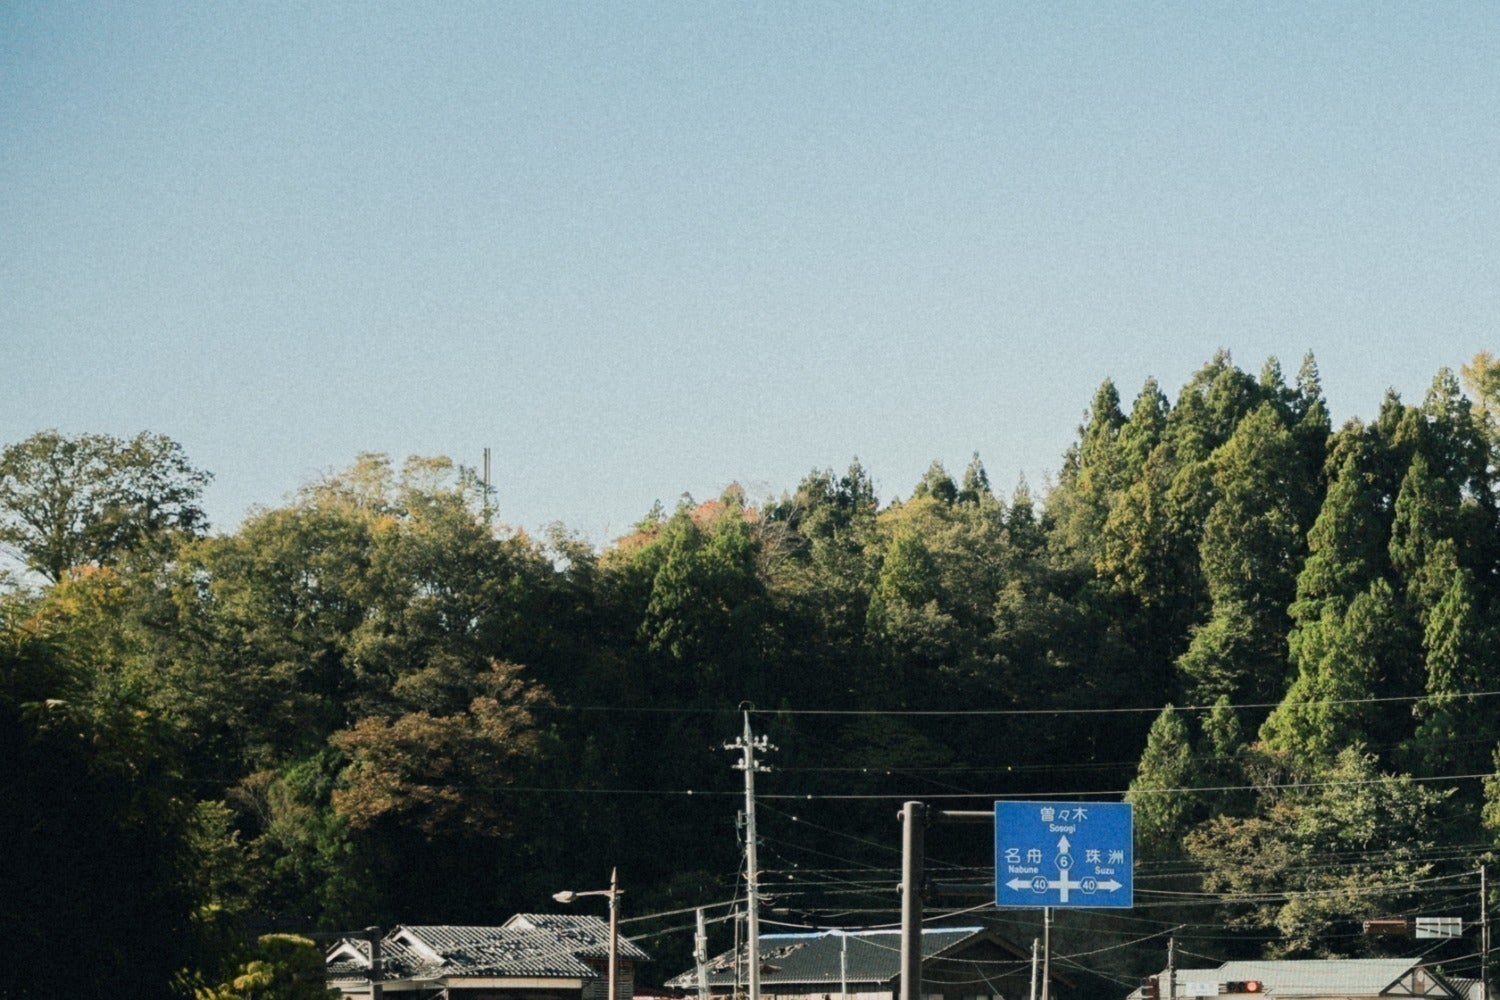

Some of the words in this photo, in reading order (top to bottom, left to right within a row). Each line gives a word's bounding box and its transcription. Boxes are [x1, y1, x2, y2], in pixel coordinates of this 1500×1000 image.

[1049, 824, 1076, 834] Sosogi
[1005, 848, 1042, 864] 名舟
[1085, 849, 1124, 865] 珠洲
[1060, 856, 1068, 867] 6
[1008, 865, 1039, 874] Nabune
[1094, 866, 1115, 875] Suzu
[1033, 880, 1046, 890] 40
[1082, 881, 1095, 890] 40
